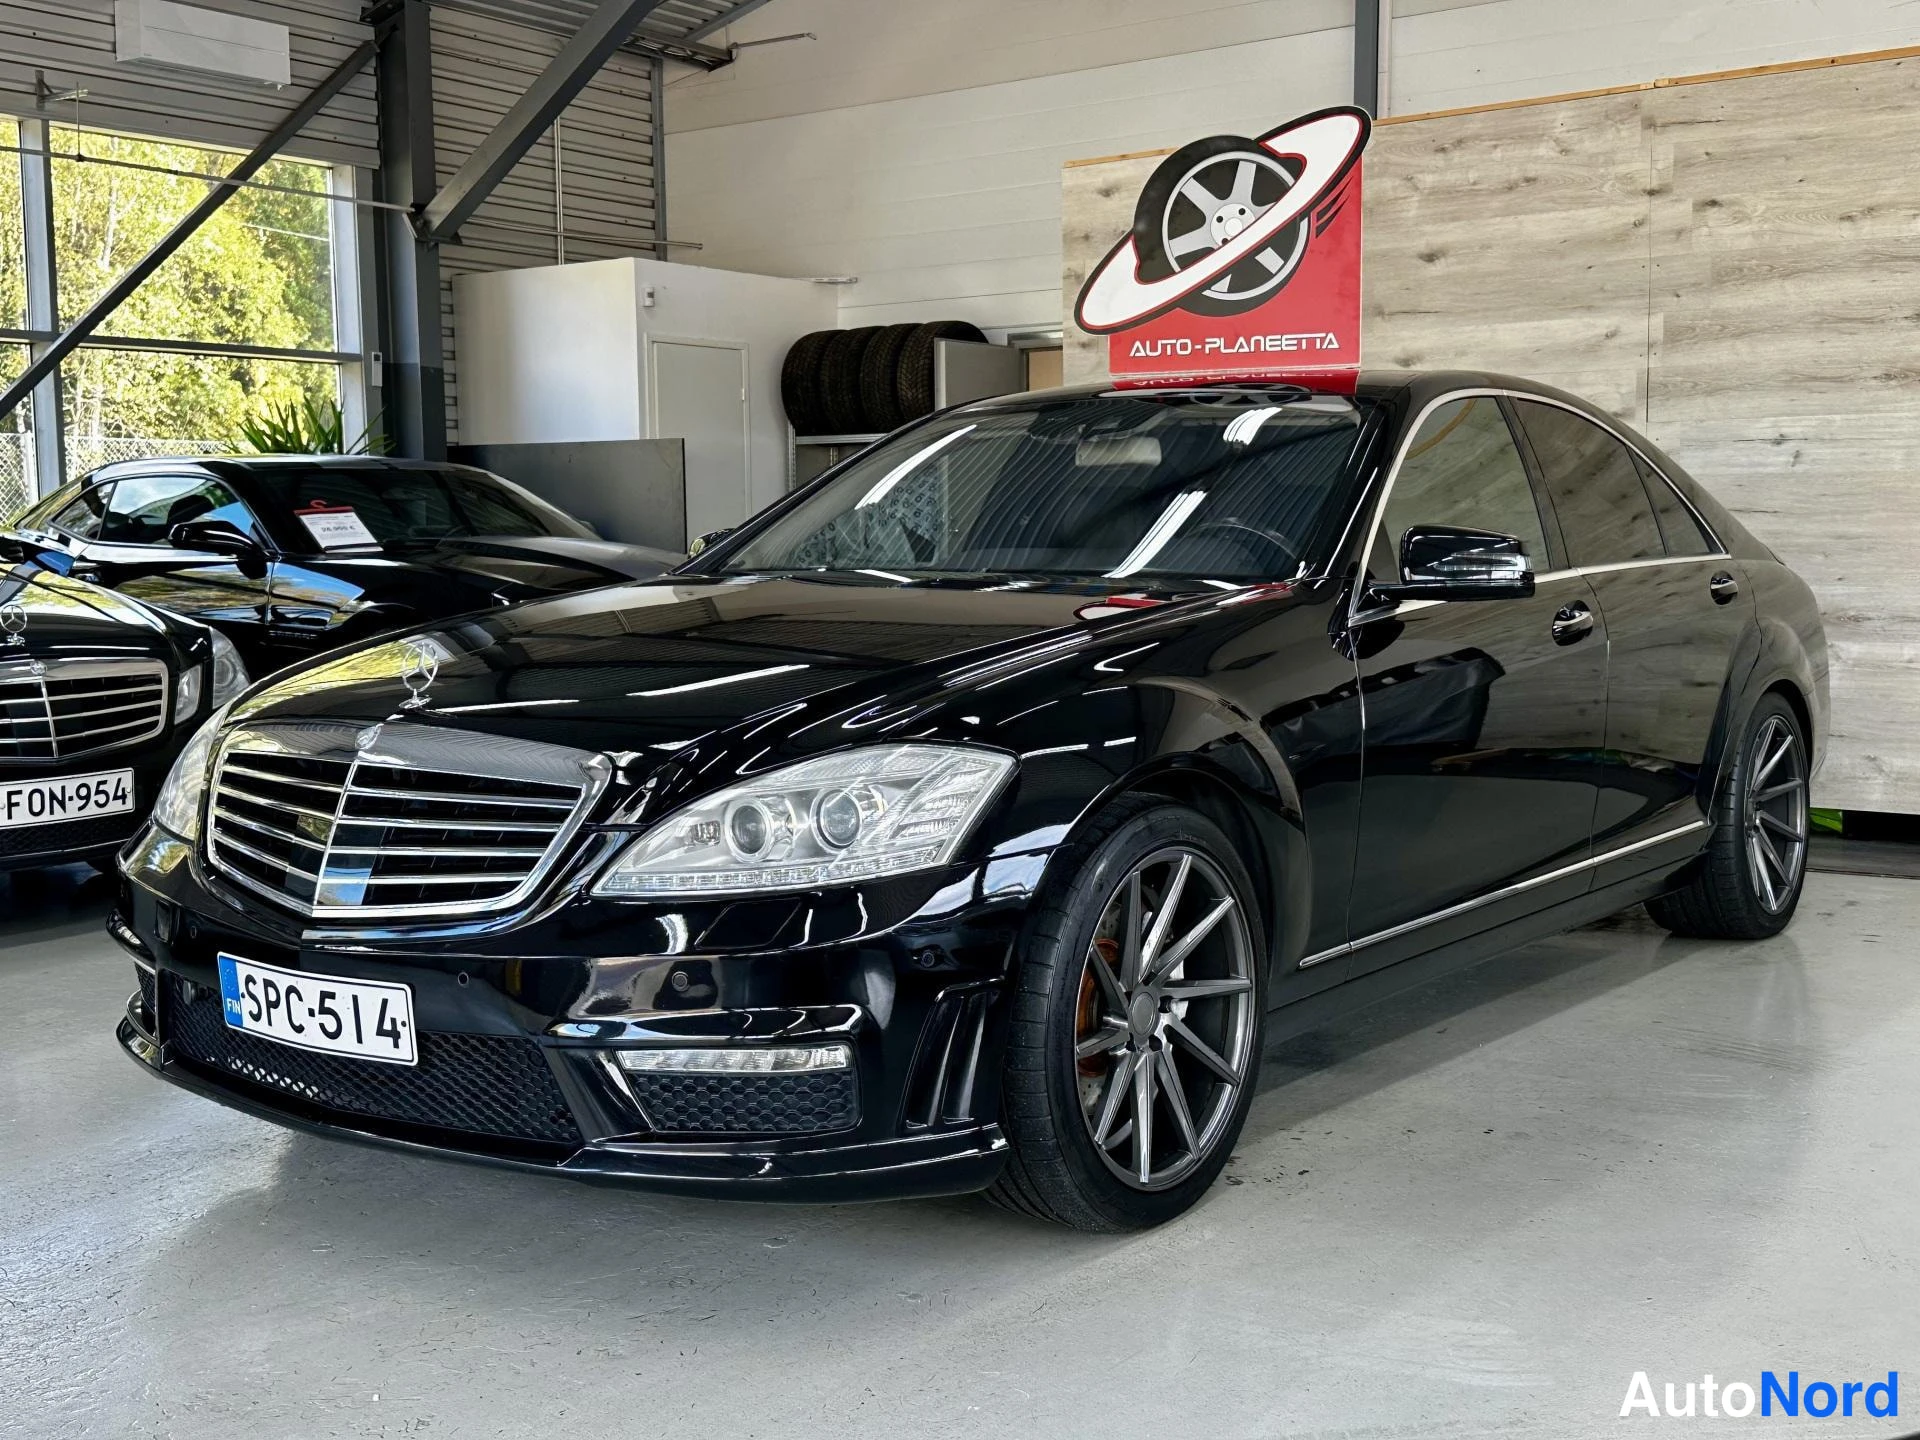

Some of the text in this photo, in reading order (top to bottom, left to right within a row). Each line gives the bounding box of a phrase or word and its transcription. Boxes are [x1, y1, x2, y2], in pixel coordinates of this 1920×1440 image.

[1129, 332, 1339, 357] AUTO-PLANEETTA
[6, 777, 128, 820] FON-954
[226, 998, 242, 1015] FIN
[244, 974, 401, 1049] SPC-514
